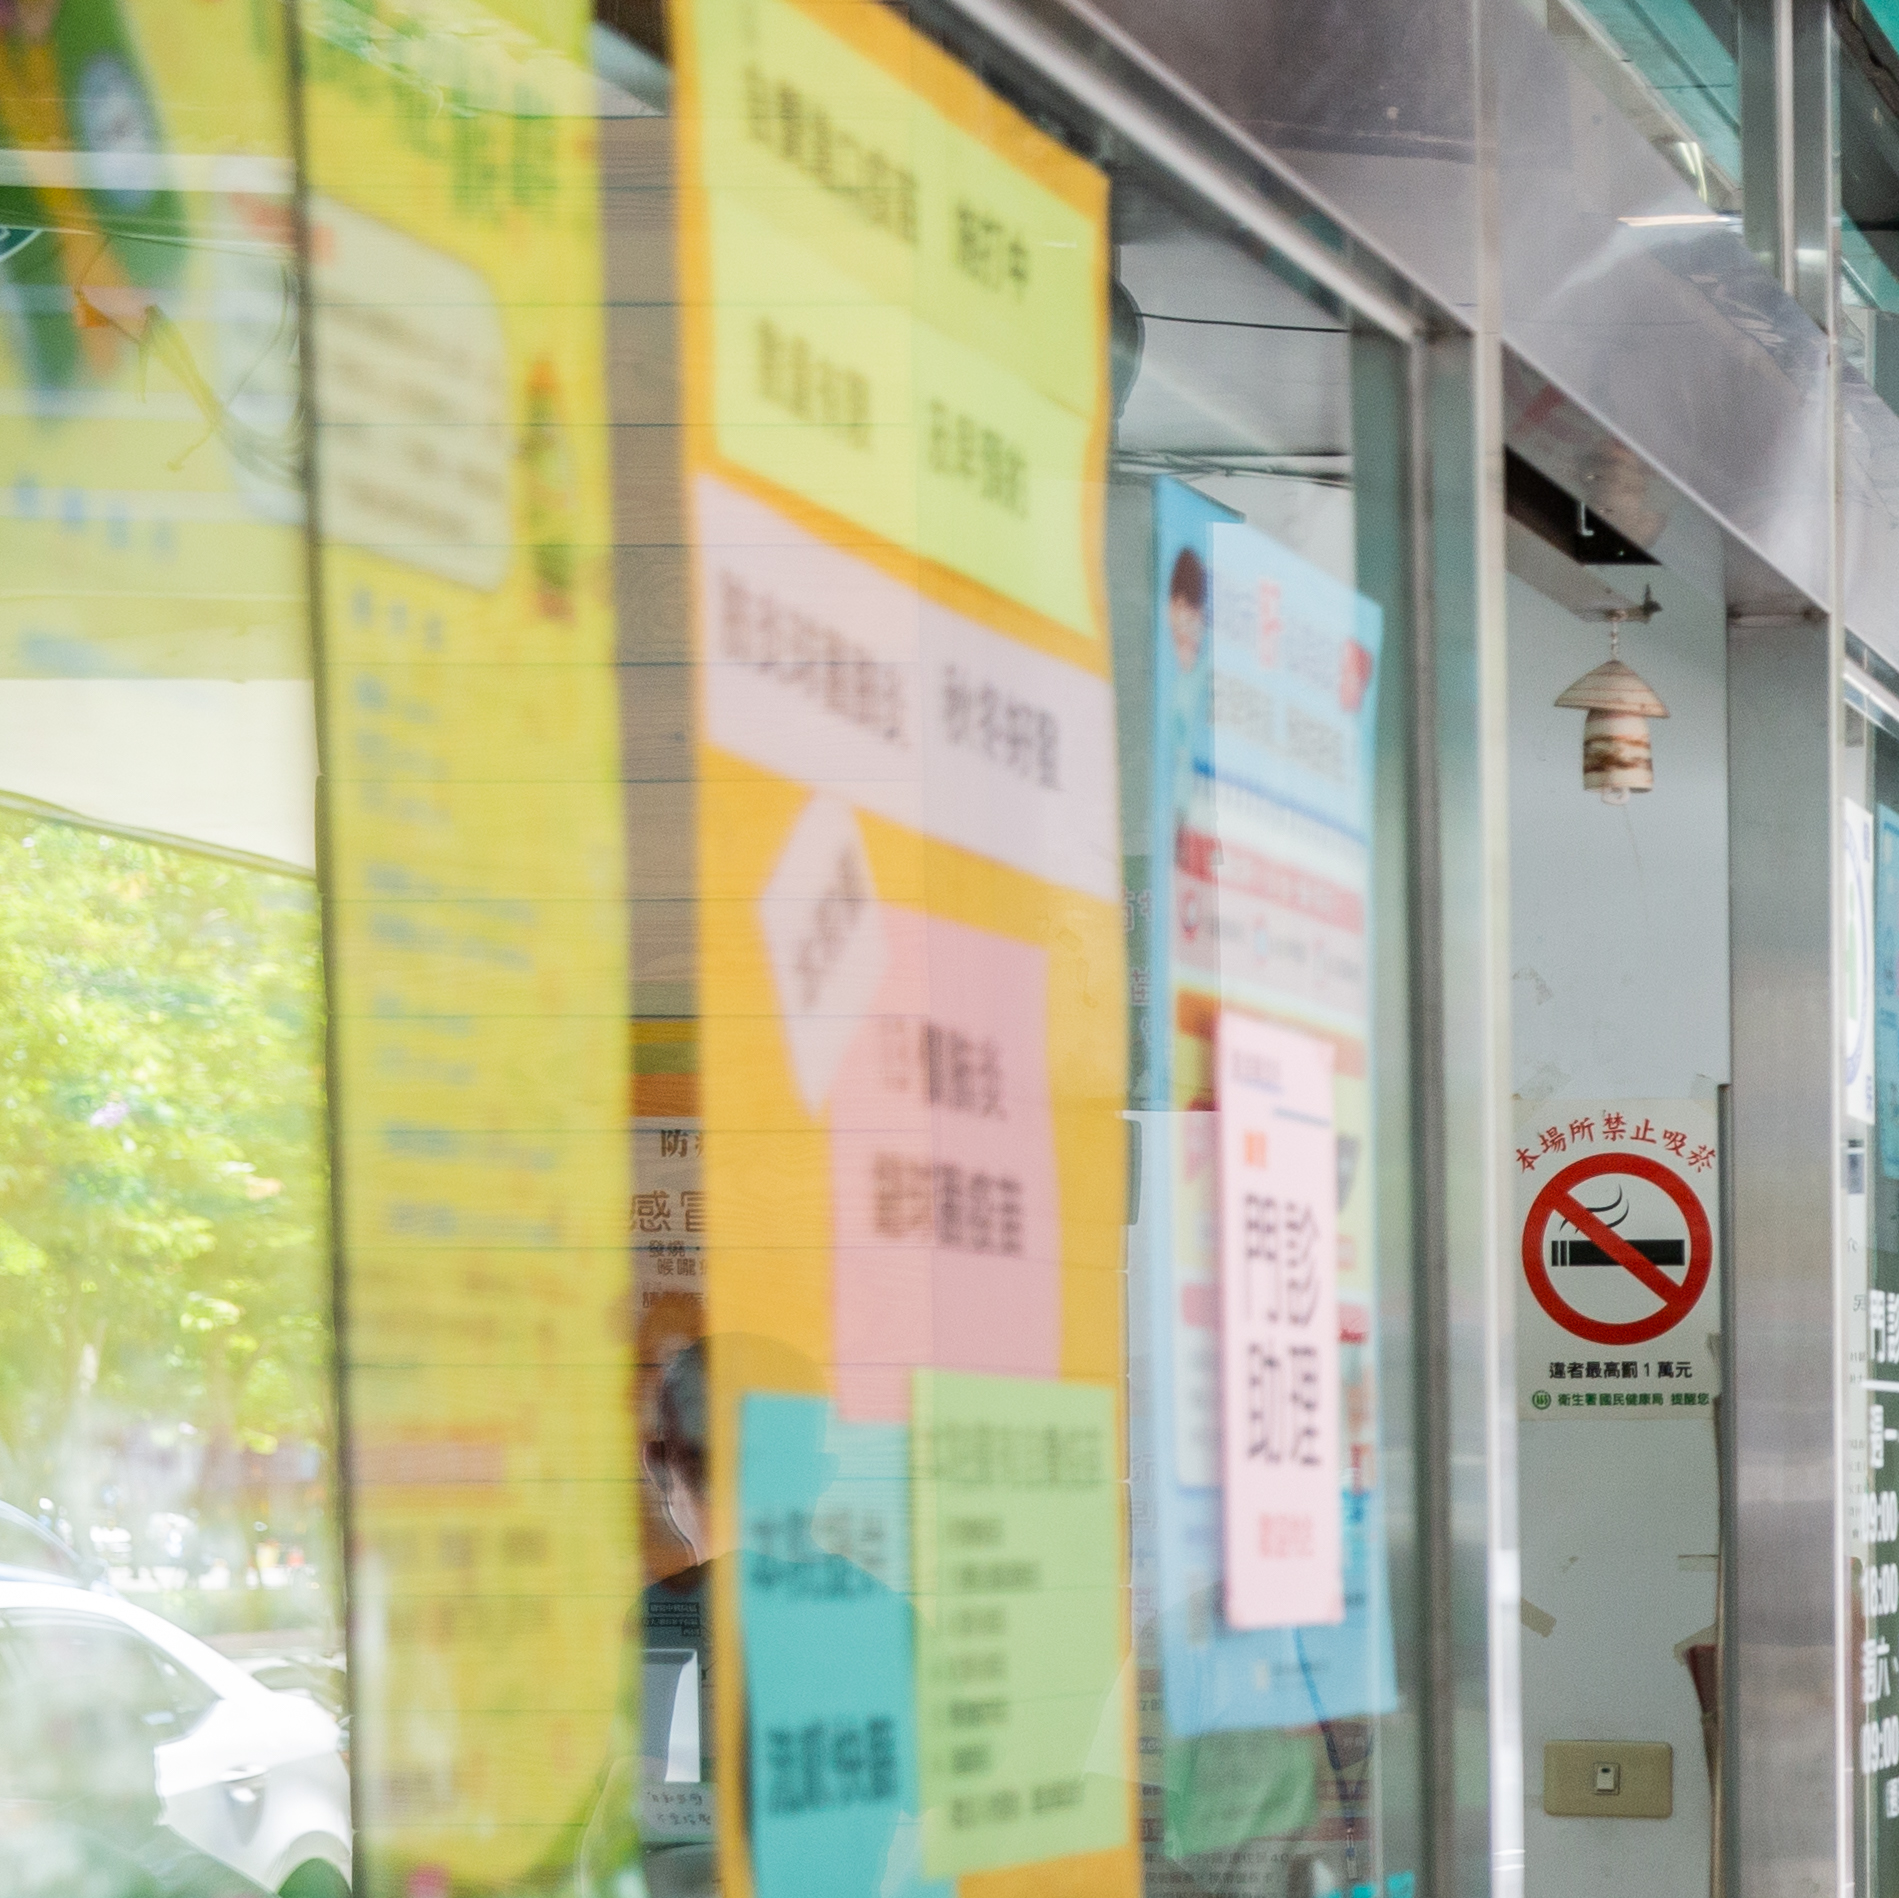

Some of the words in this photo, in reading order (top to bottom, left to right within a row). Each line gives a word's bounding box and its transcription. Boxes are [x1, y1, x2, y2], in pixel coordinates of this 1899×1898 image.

[1514, 1111, 1717, 1175] 本場所禁止吸菸
[1549, 1360, 1639, 1380] 違者最高罰
[1657, 1360, 1694, 1380] 萬元
